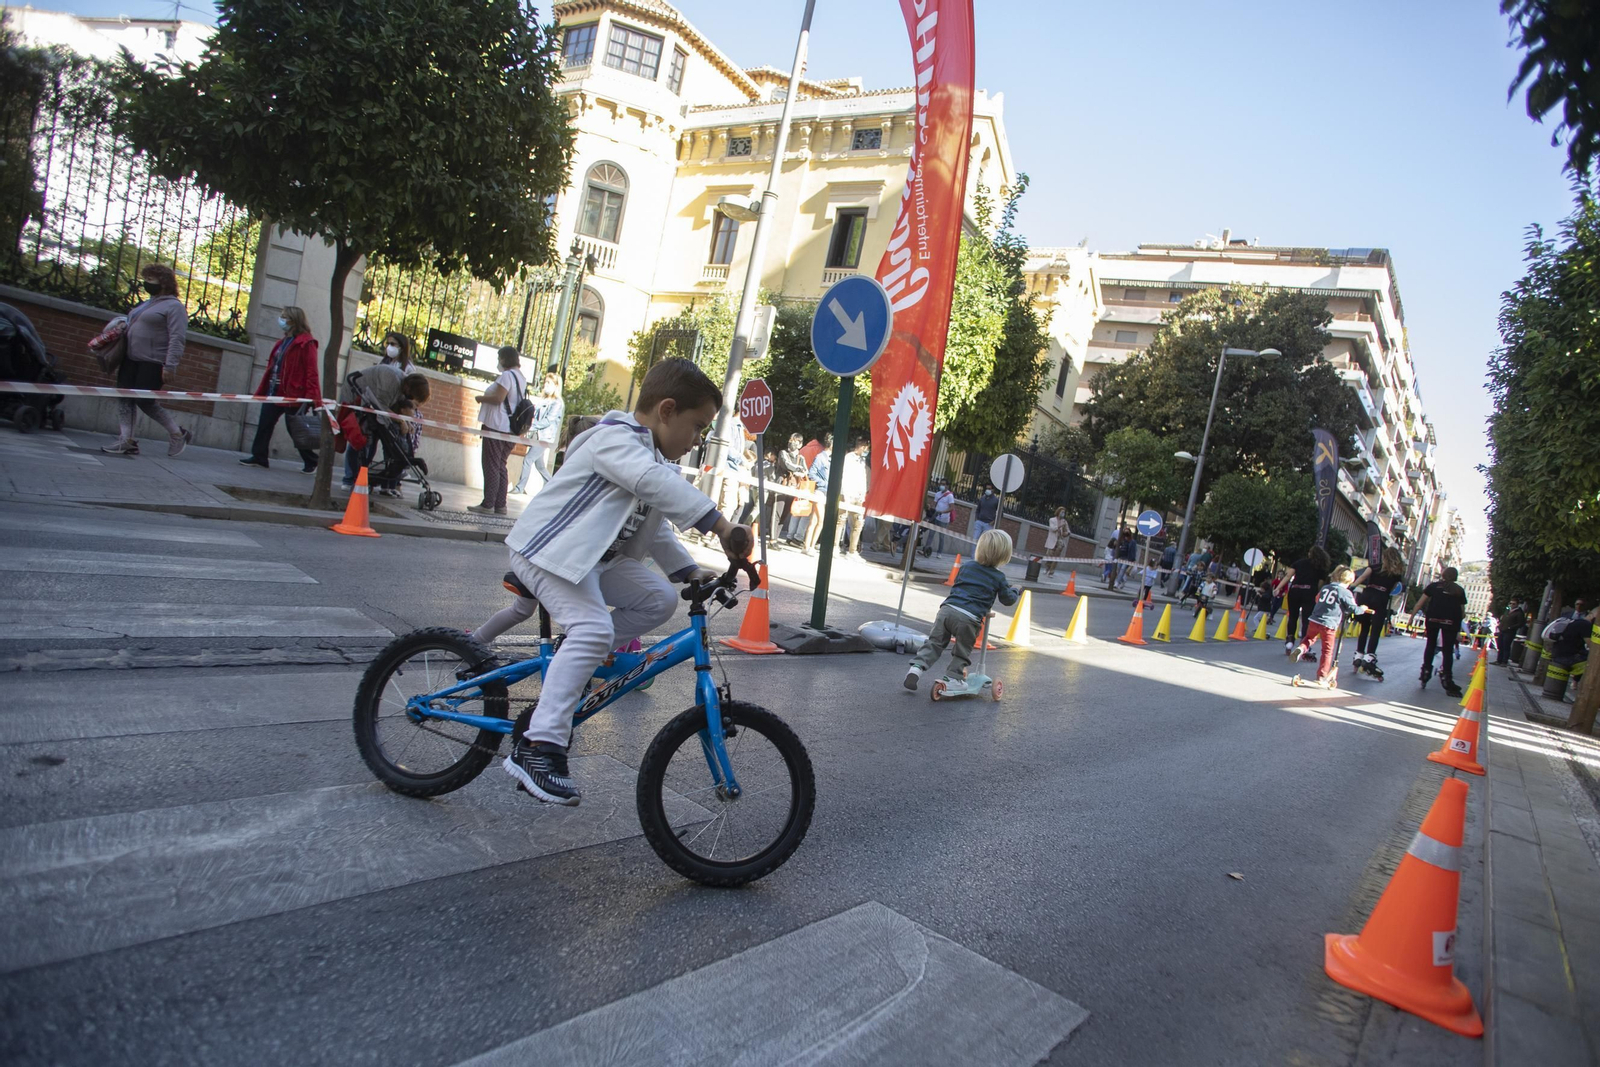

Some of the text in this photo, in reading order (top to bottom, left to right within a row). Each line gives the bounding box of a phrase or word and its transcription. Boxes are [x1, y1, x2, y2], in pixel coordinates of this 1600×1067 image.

[440, 340, 474, 357] Los Patos
[741, 395, 771, 418] STOP
[1318, 588, 1338, 605] 36
